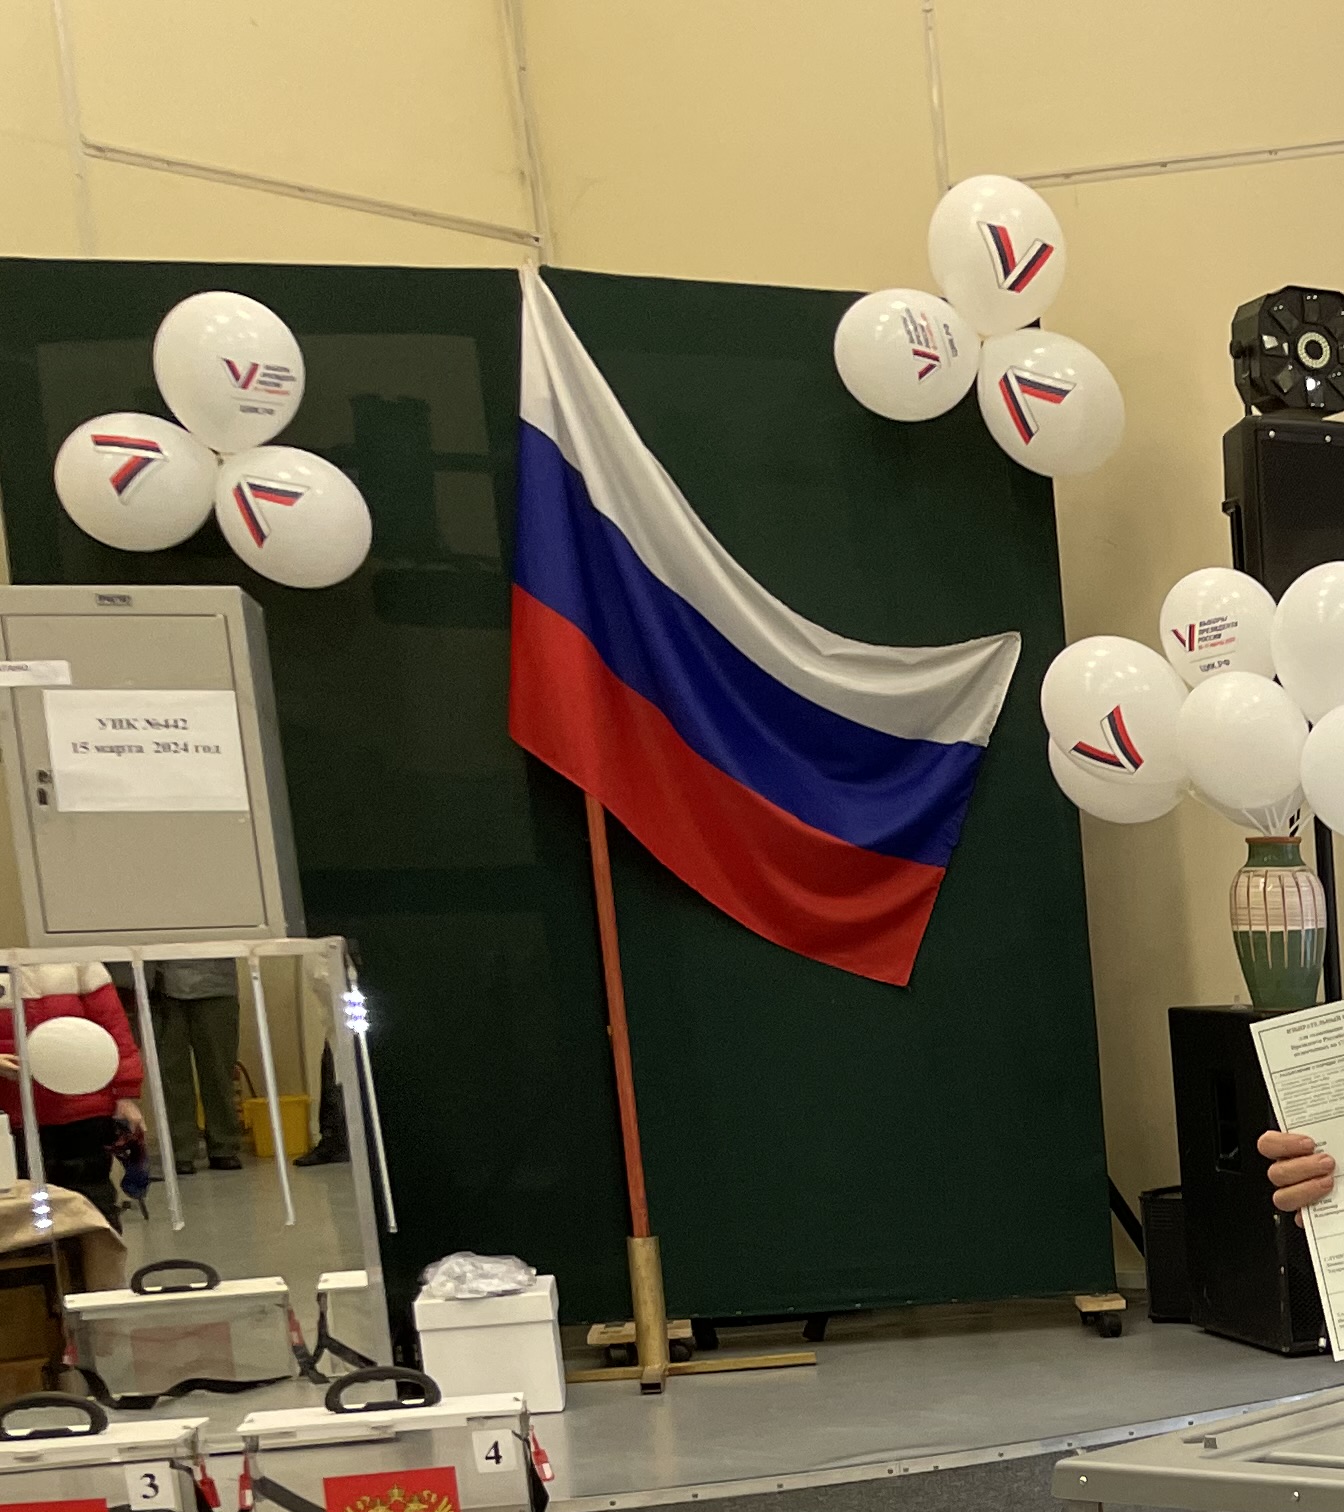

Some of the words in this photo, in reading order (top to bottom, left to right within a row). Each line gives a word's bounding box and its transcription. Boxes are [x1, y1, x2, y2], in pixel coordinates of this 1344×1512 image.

[153, 741, 189, 754] 2024
[485, 1440, 504, 1466] 4
[139, 1473, 159, 1499] 3
